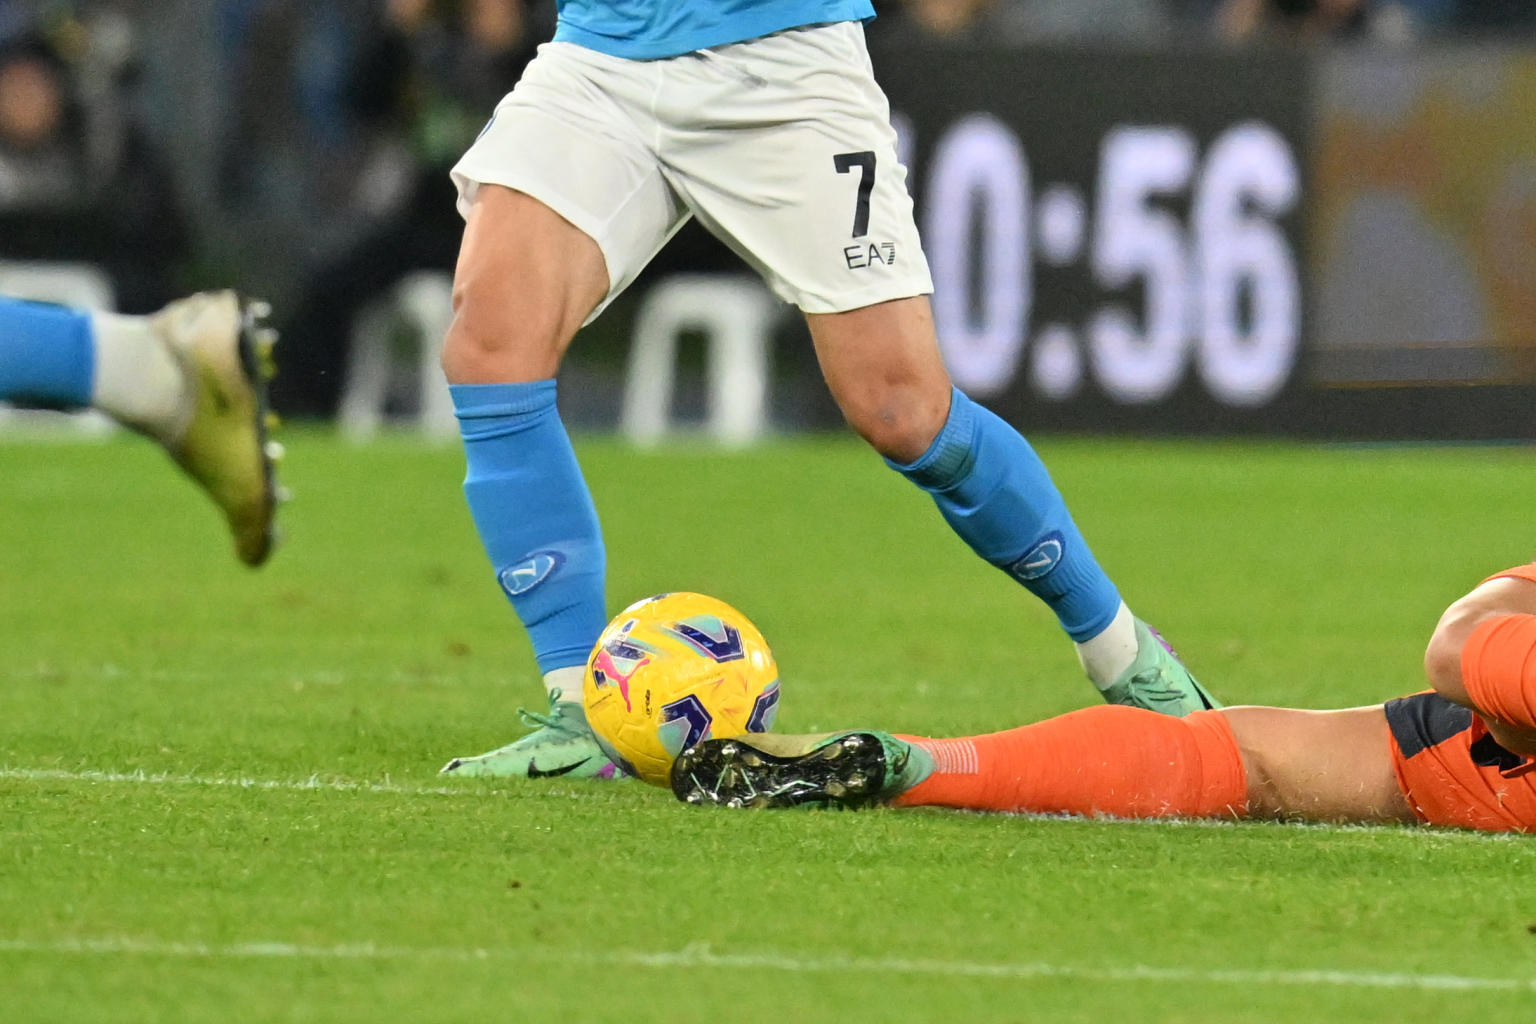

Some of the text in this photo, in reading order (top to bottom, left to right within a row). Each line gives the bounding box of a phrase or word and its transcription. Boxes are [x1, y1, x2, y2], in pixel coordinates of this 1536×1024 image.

[833, 151, 877, 238] 7
[844, 242, 896, 269] EA7
[897, 112, 1301, 406] 0:56
